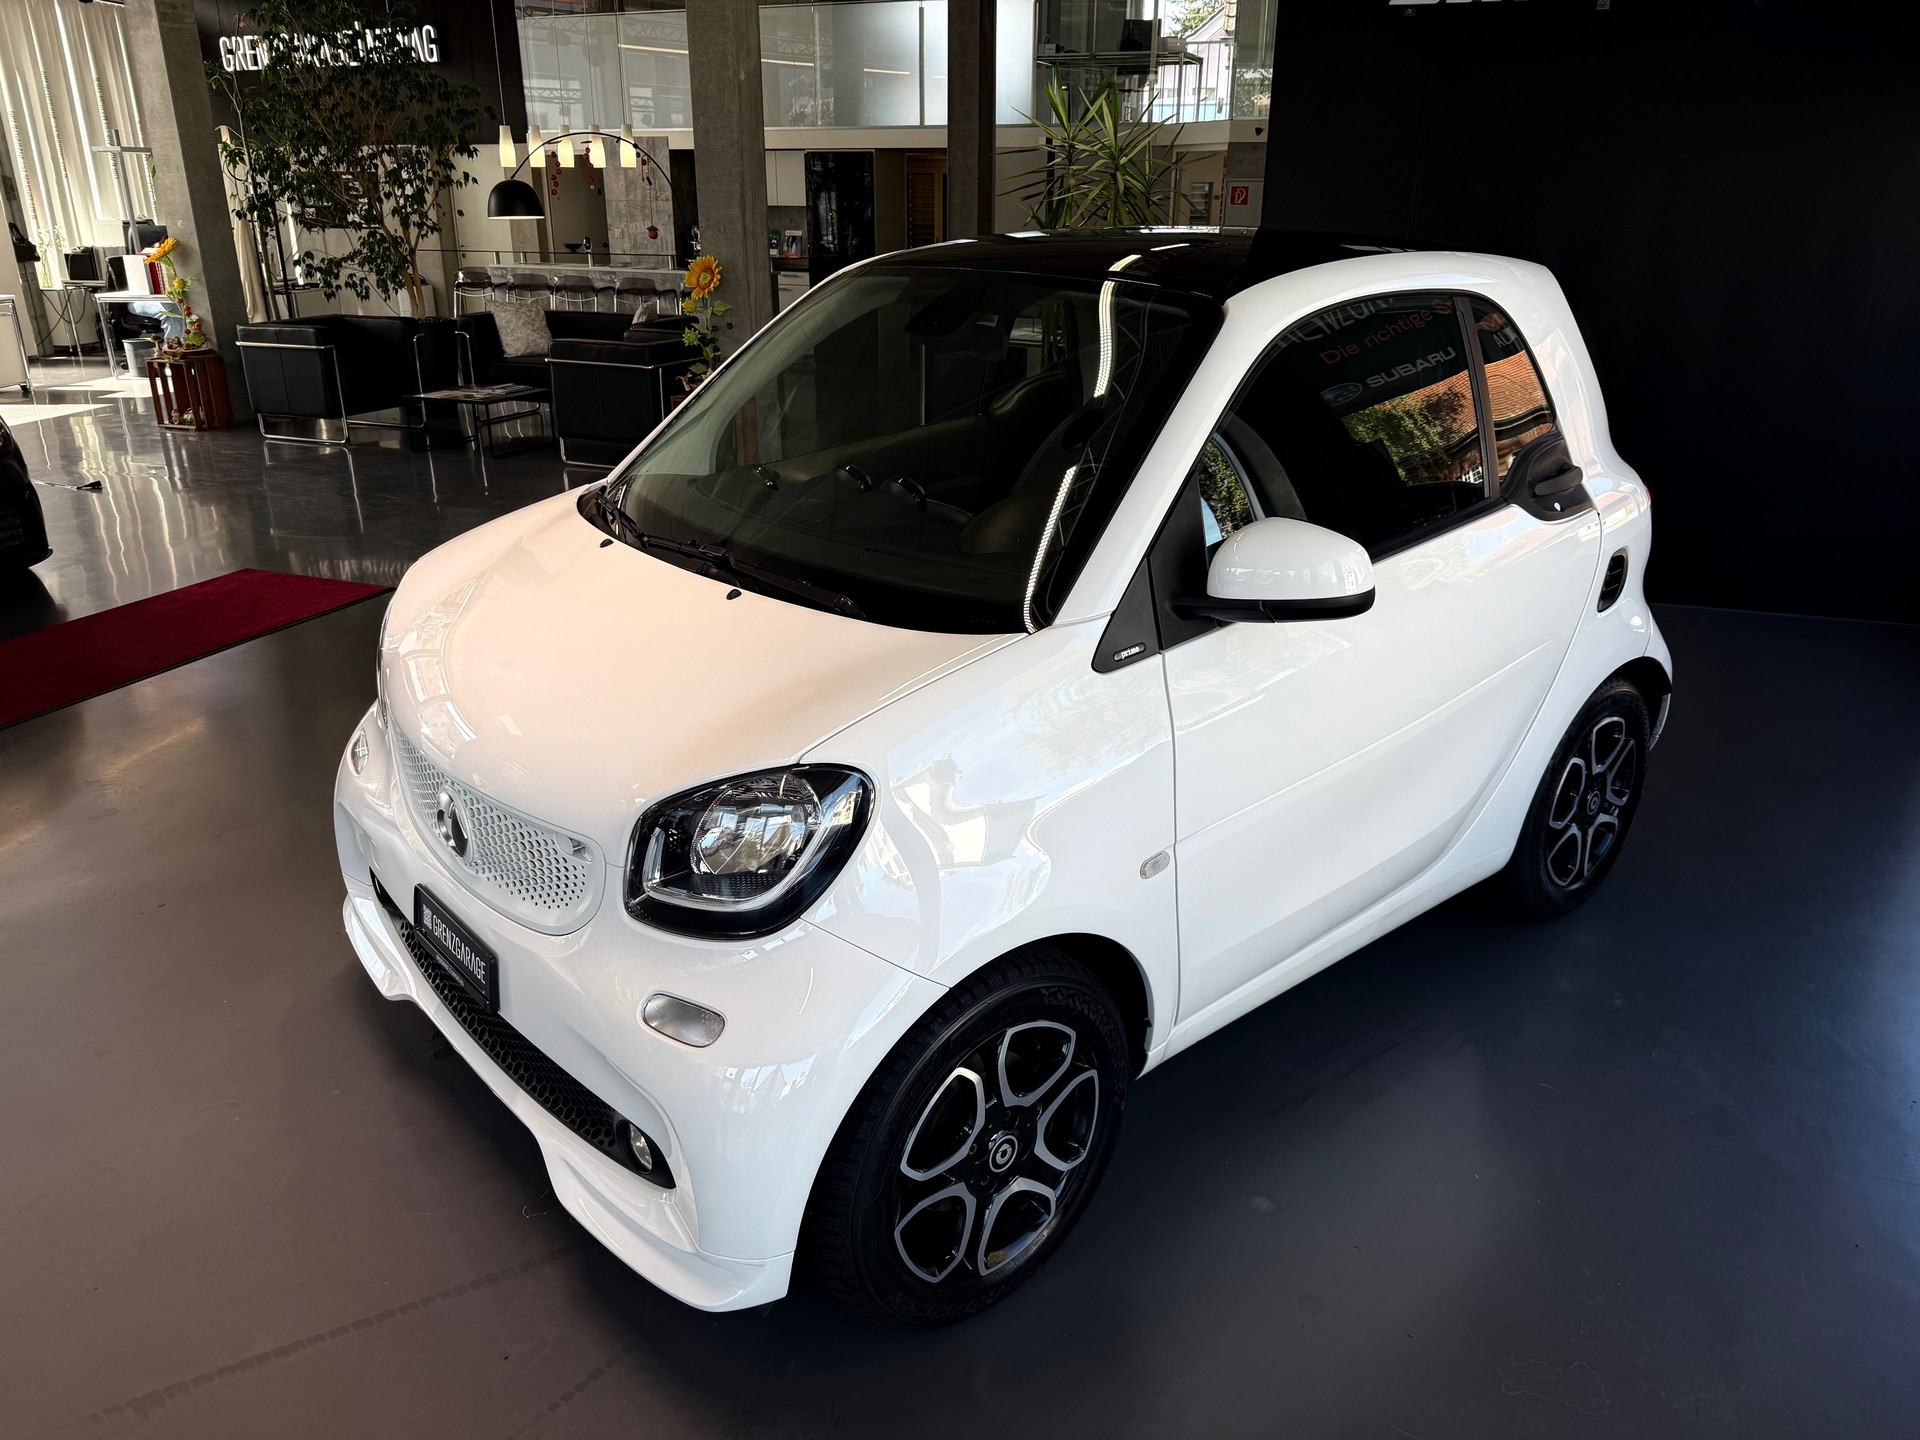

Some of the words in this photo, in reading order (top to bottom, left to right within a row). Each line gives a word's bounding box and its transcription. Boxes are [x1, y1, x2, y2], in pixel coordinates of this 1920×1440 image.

[1318, 343, 1361, 367] Die
[1363, 309, 1433, 349] richtige
[1366, 346, 1457, 388] SUBARU
[432, 914, 486, 985] GRENZGARAGE
